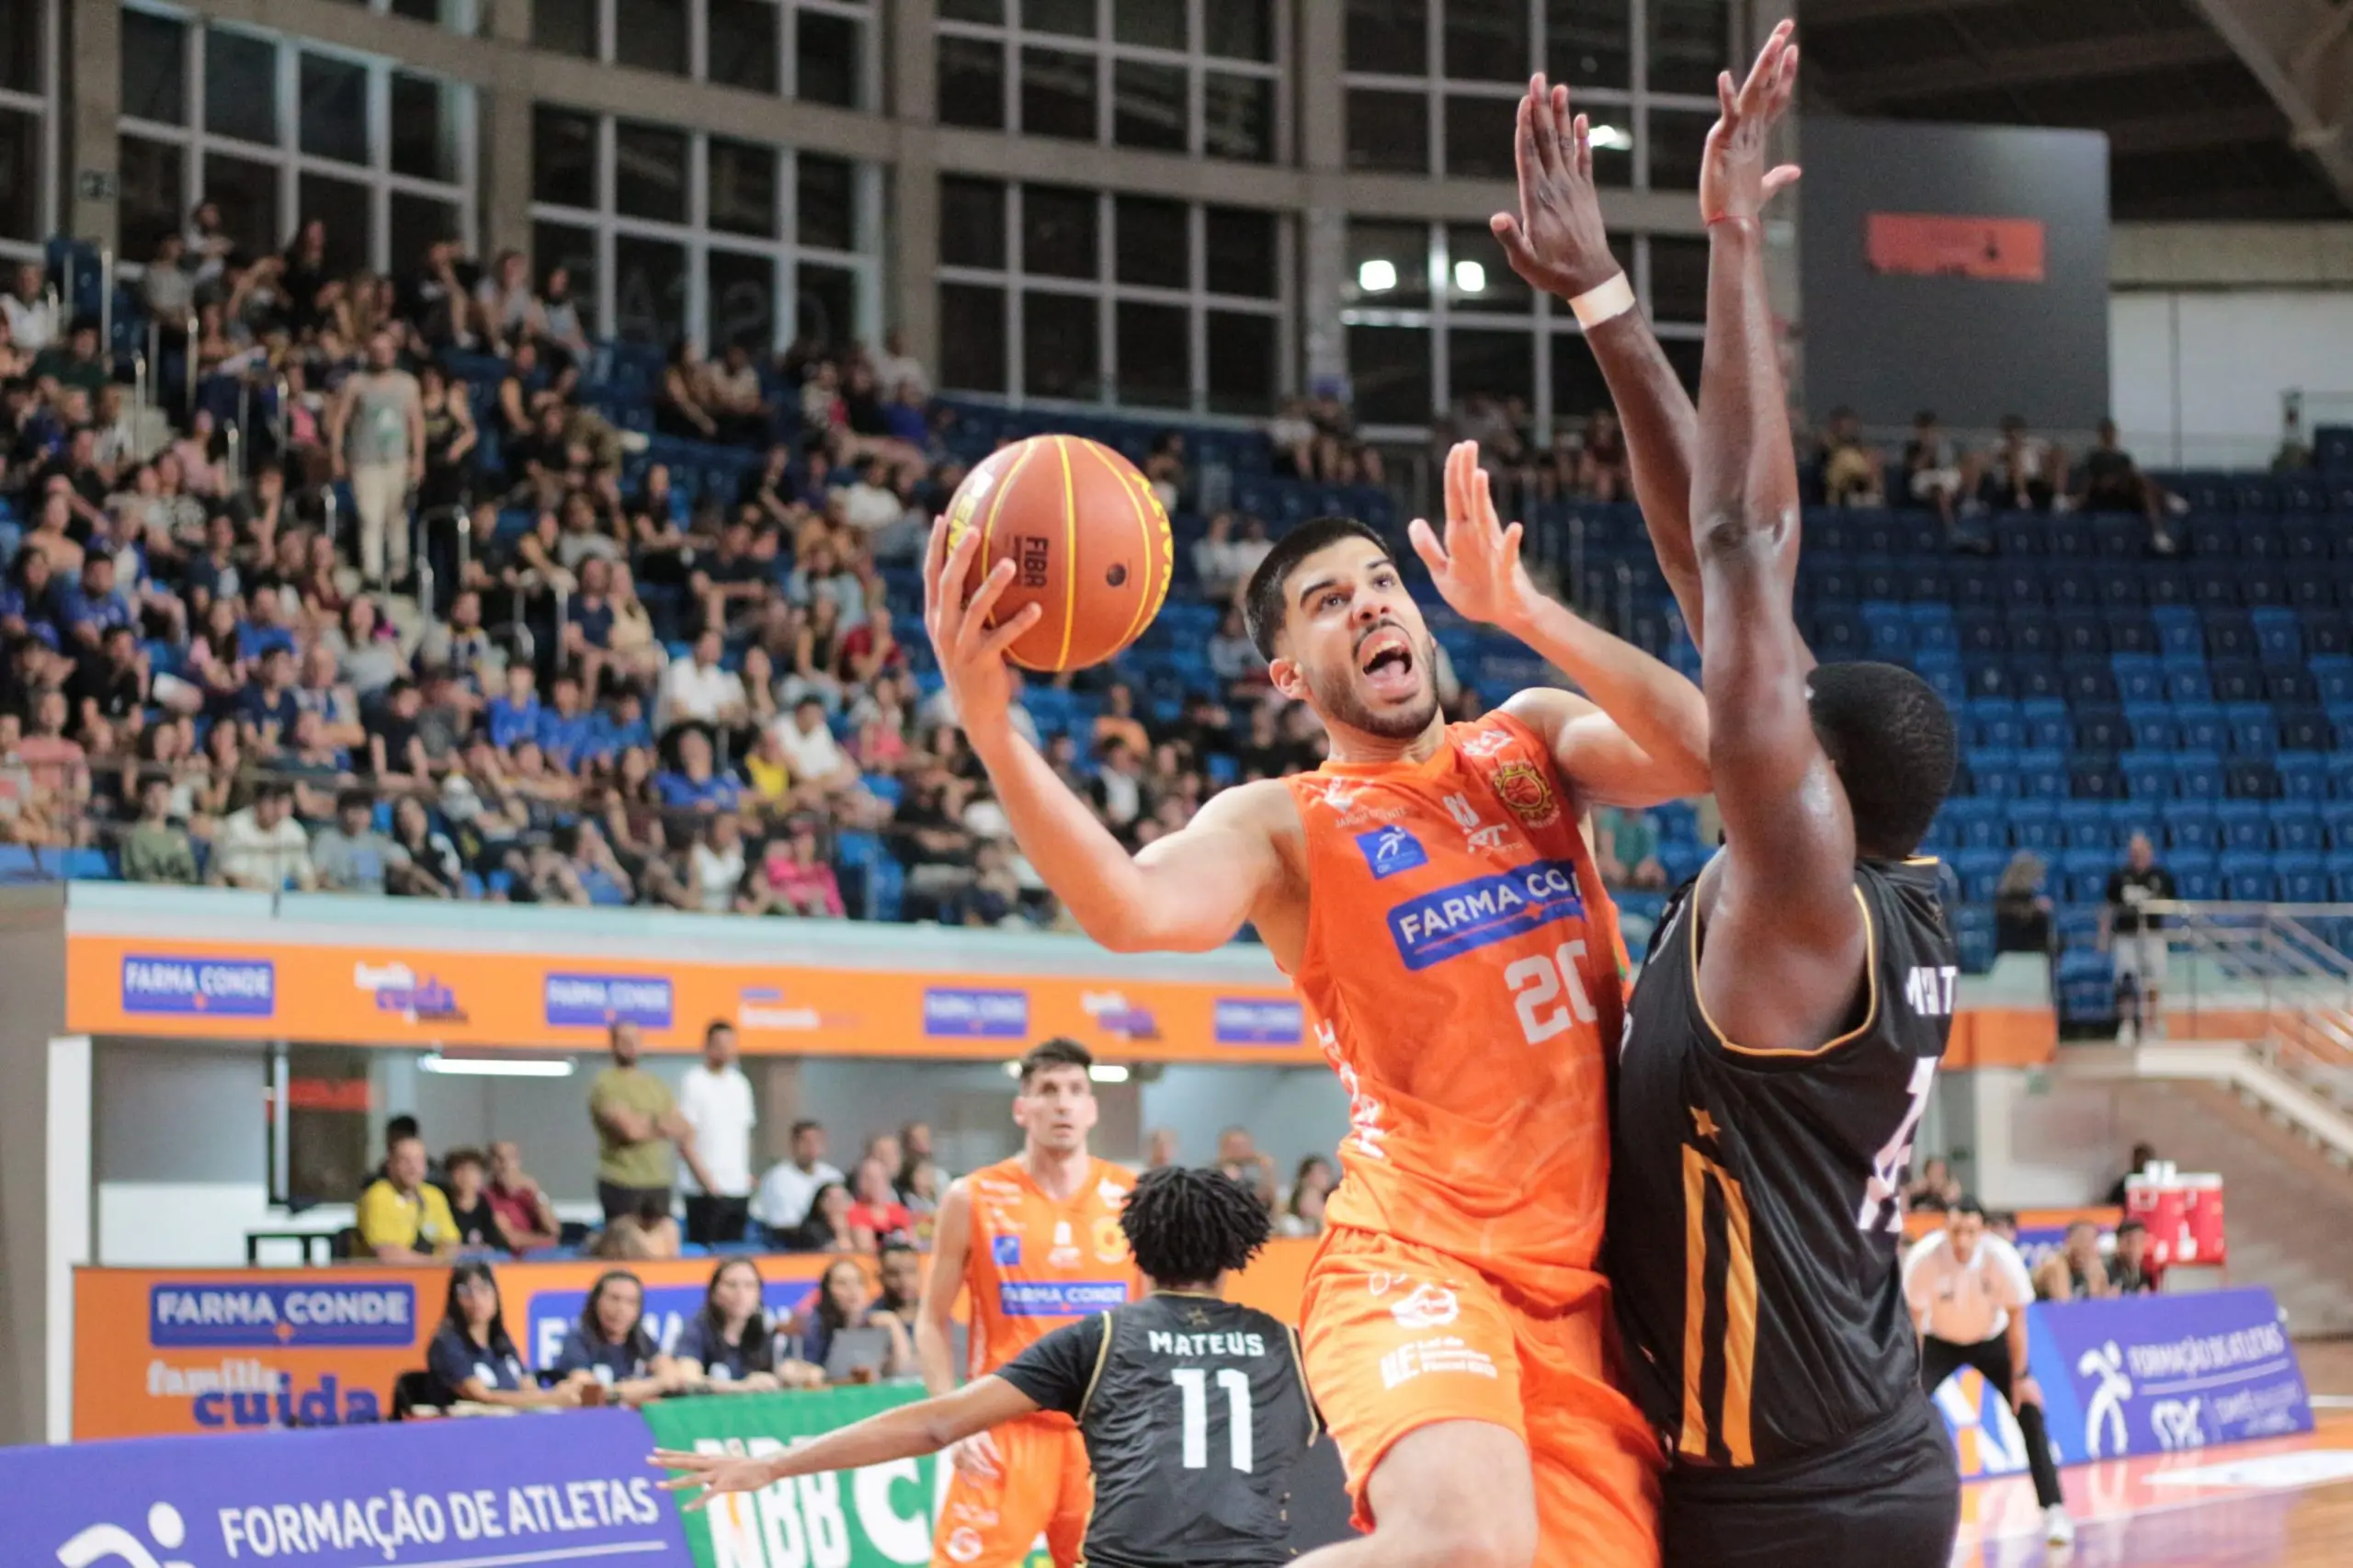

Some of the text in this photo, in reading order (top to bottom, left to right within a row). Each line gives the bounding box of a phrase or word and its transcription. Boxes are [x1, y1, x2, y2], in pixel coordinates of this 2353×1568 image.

[1399, 884, 1523, 944] FARMA
[157, 1291, 410, 1324] FARMA CONDE
[1148, 1330, 1266, 1357] MATEUS
[193, 1372, 381, 1427] cuida
[1171, 1369, 1254, 1474] 11
[219, 1476, 660, 1560] FORMAÇÃO DE ATLETAS
